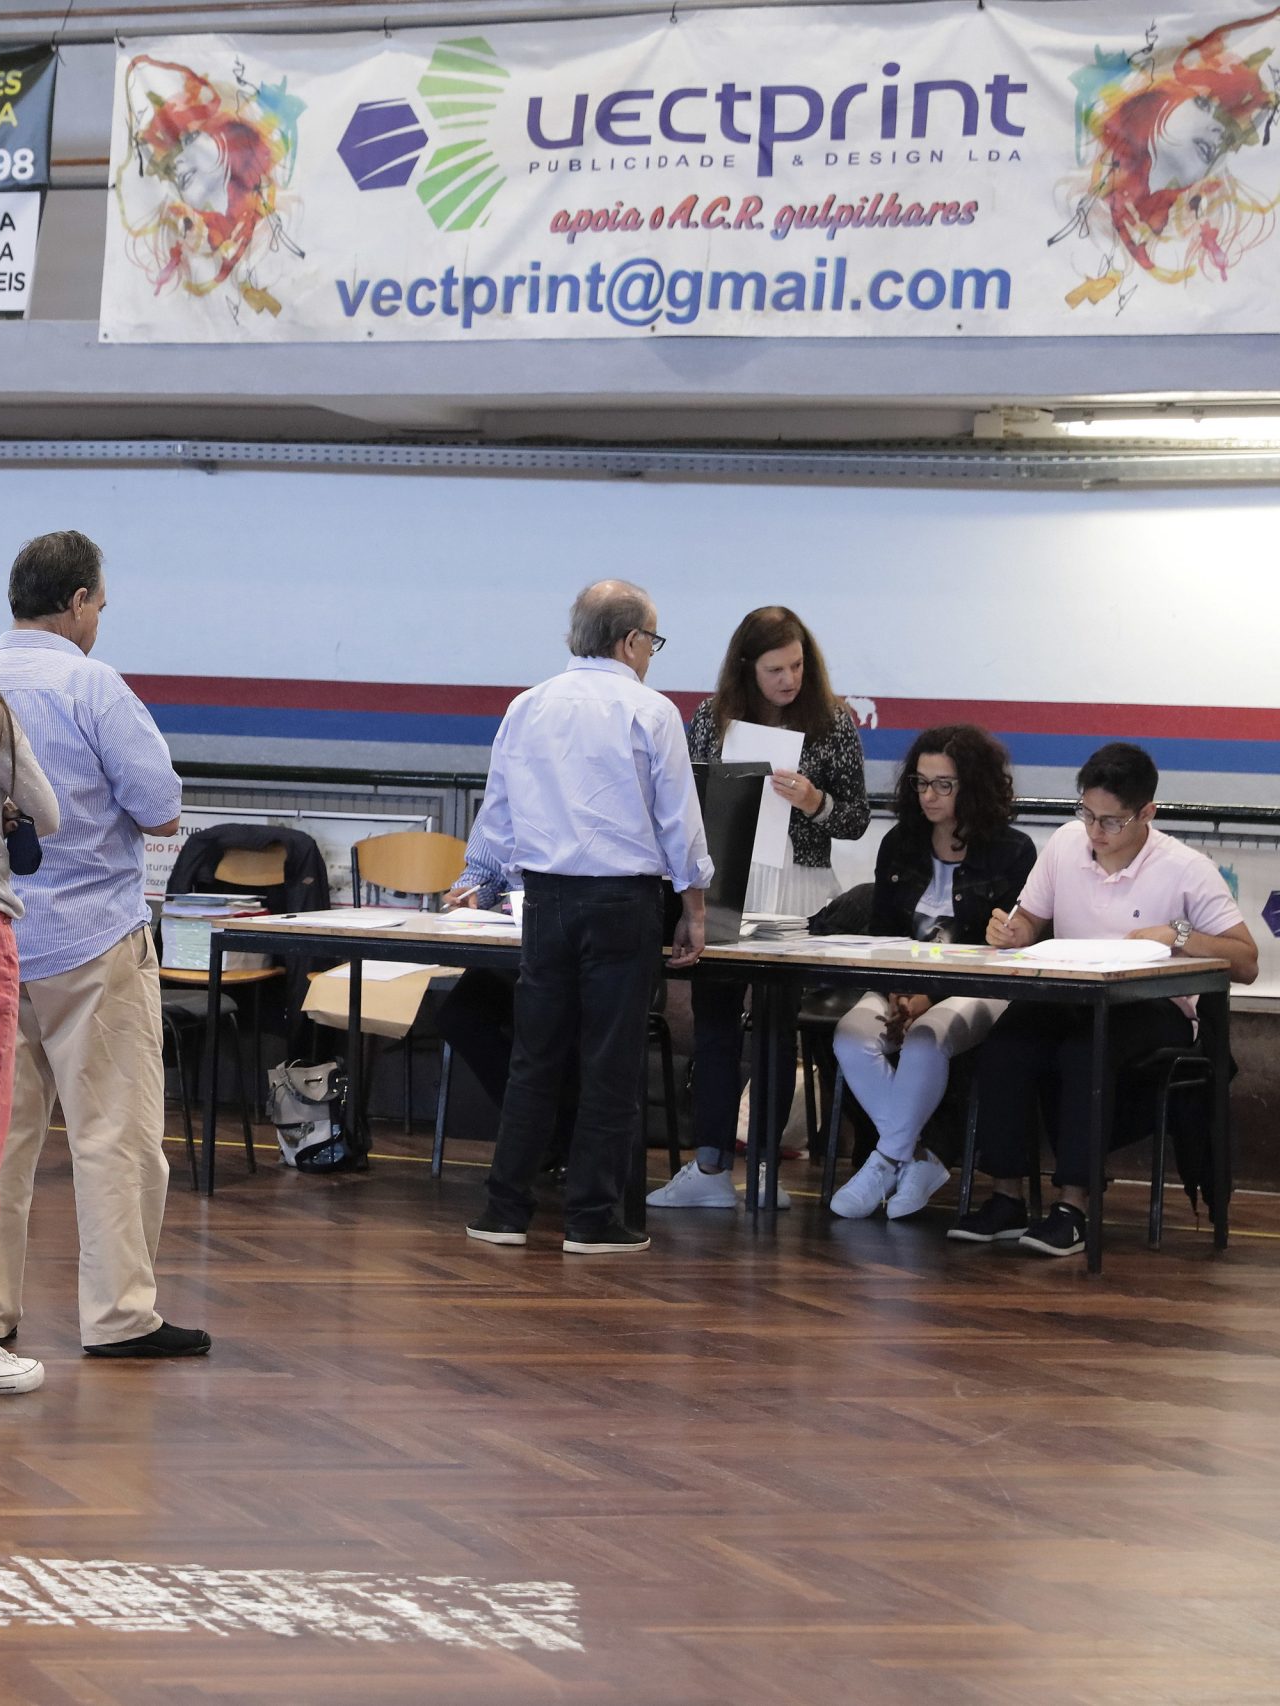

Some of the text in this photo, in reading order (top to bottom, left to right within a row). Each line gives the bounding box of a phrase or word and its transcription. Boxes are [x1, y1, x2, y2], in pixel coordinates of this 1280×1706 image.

[528, 149, 1022, 174] PUBLICIDADE & DESIGN LDA
[550, 191, 979, 245] apoia o A.C.R. gulpilhares
[334, 256, 1012, 330] vectprint@gmail.com
[167, 843, 183, 854] FA
